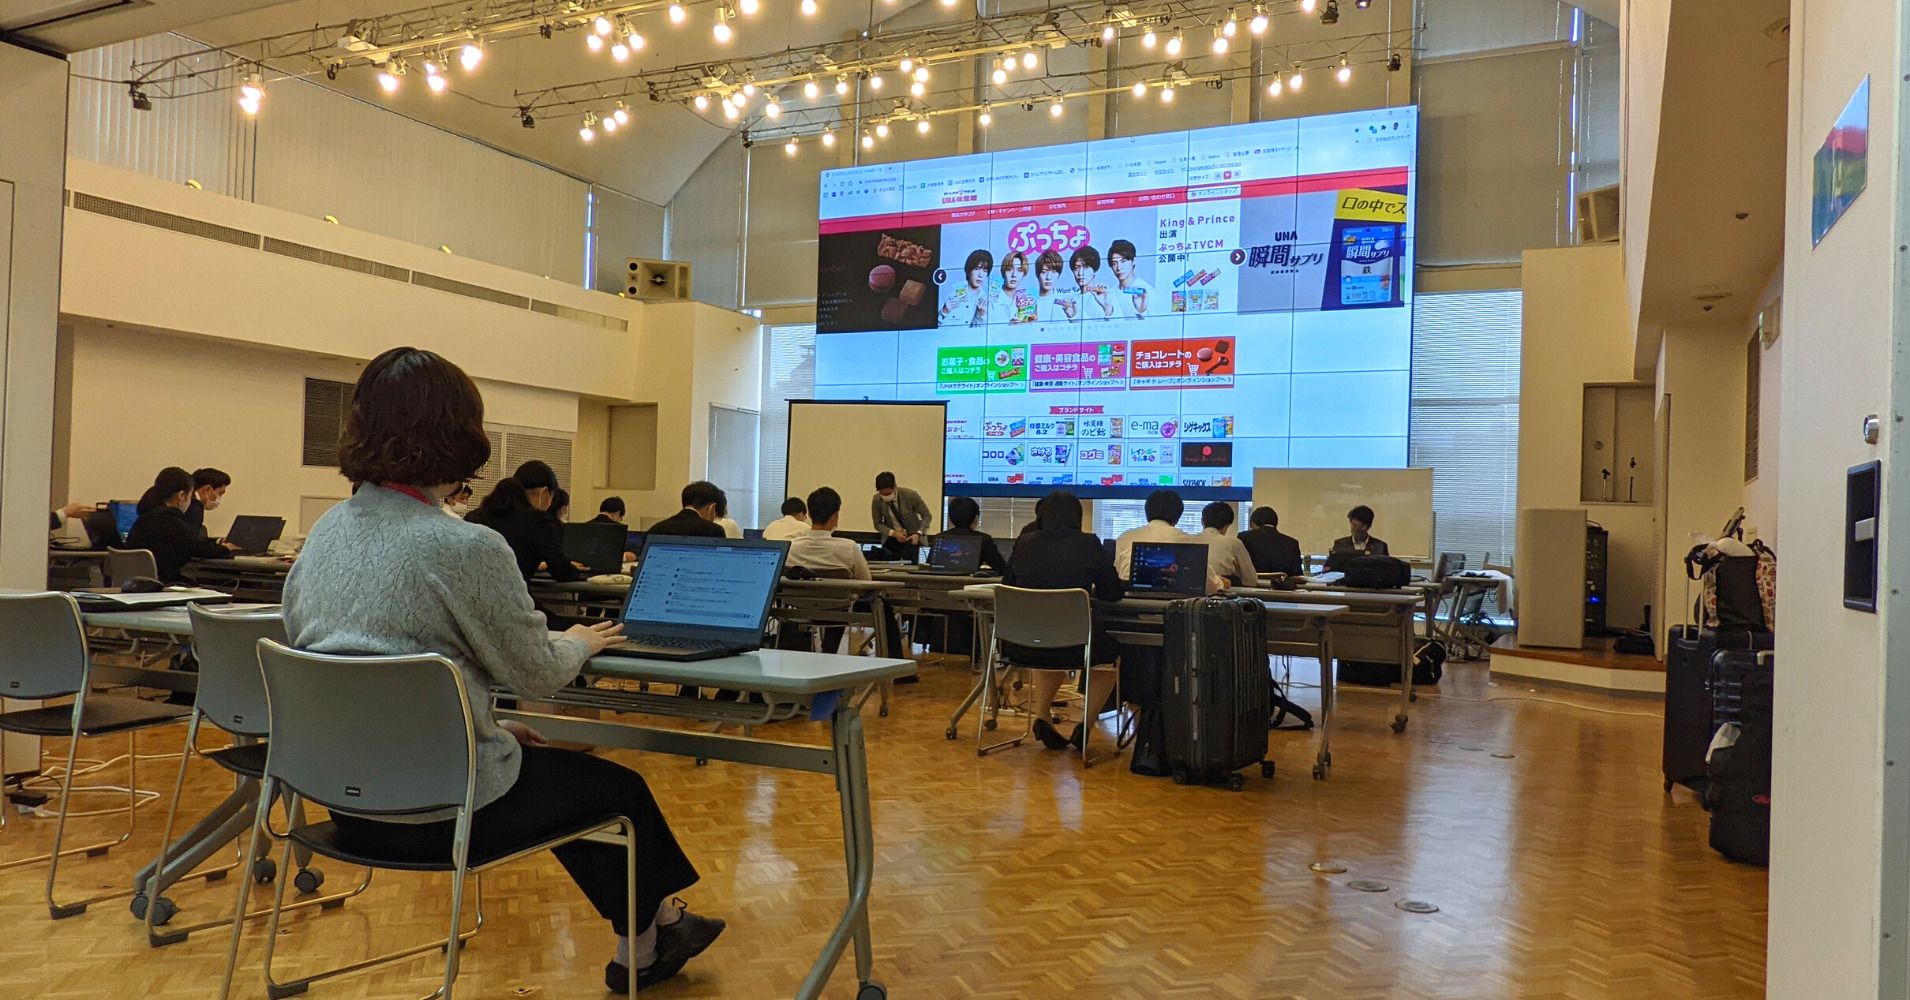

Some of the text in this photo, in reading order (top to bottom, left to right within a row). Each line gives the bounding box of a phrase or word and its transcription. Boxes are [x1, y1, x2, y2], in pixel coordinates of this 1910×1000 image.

[1160, 214, 1236, 229] King & Prince
[1010, 222, 1087, 252] ぷっちょ
[1159, 229, 1177, 239] 出演
[1274, 230, 1298, 242] UHA
[1248, 243, 1324, 268] 瞬間サプリ
[1034, 352, 1096, 364] 健康・美容食品の
[1135, 349, 1192, 361] チョコレートの
[941, 356, 990, 367] お菓子・食品の
[1135, 360, 1182, 369] ご購入はコチラ
[940, 366, 981, 375] ご購入はコチラ
[1034, 363, 1078, 372] ご購入はコチラ
[1130, 420, 1159, 431] e-ma
